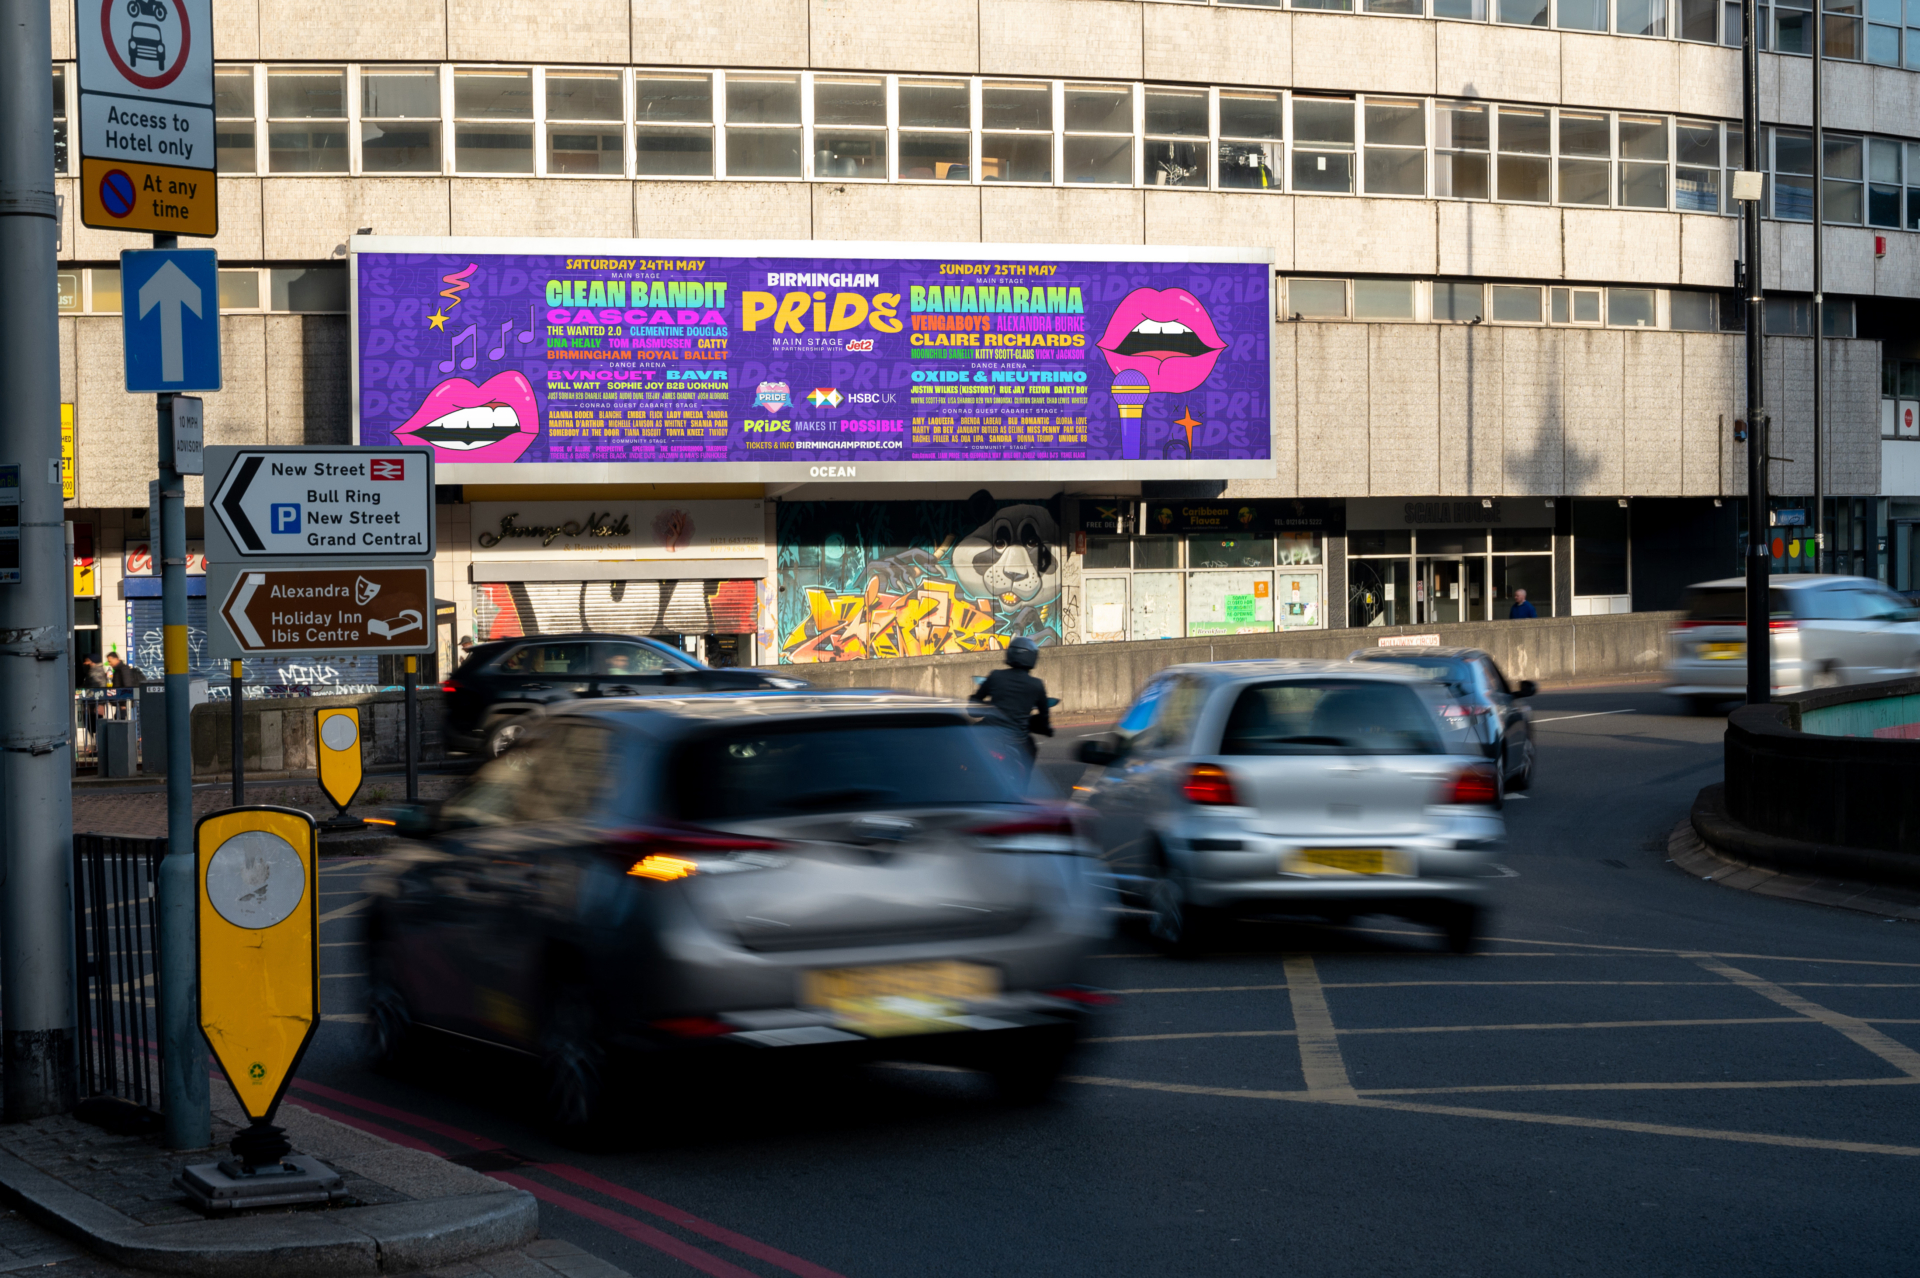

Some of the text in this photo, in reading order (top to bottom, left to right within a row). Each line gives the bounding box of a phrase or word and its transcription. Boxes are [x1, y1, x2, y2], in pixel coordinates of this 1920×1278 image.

[108, 106, 189, 132] Access to
[106, 130, 193, 160] Hotel only
[143, 174, 197, 200] At any
[152, 199, 189, 219] time
[566, 259, 706, 271] SATURDAY 24TH MAY
[940, 264, 1057, 276] SUNDAY 25TH MAY
[768, 273, 879, 287] BIRMINGHAM
[546, 280, 727, 308] CLEAN BANDIT
[910, 285, 1084, 314] BANANARAMA
[547, 309, 727, 325] CASCADA
[911, 315, 1085, 332] VENGABOYS ALEXANDRA BURKE
[547, 326, 728, 336] THE WANTED 2.0 CLEMENTINE DOUGLAS
[547, 338, 727, 348] UNA HEALY TOM RASMUSSEN CATTY
[773, 338, 802, 346] MAIN
[808, 338, 843, 346] STAGE
[910, 334, 1085, 347] CLAIRE RICHARDS
[548, 350, 728, 360] BIRMINGHAM ROYAL BALLET
[911, 349, 1085, 359] MOONCHILD SANELLY KITTY SCOTT-CLAUS VICKY JACKSON
[548, 370, 727, 380] BVNQUET BAVR
[911, 371, 1087, 382] OXIDE & NEUTRINO
[548, 382, 728, 390] WILL WATT SOPHIE JOY B2B UOKHUN
[911, 385, 1088, 395] JUSTIN WILKES (KISSTORY) RUE JAY FELTON DAVEY BOY
[759, 394, 787, 402] PRIDE
[848, 394, 896, 403] HSBC UK
[179, 416, 198, 429] 10 MPH
[795, 422, 826, 431] MAKES
[829, 422, 837, 431] IT
[841, 420, 904, 432] POSSIBLE
[177, 440, 202, 453] ADVISORY
[796, 441, 902, 449] BIRMINGHAMPRIDE.COM
[272, 463, 365, 476] New Street
[810, 466, 856, 477] OCEAN
[307, 490, 381, 505] Bull Ring
[1182, 507, 1229, 516] Caribbean
[1405, 502, 1501, 524] SCALA HOUSE
[278, 507, 400, 531] P New Street
[1191, 516, 1220, 525] Flavaz
[479, 512, 631, 548] Jenny Nails
[307, 532, 422, 546] Grand Central
[575, 544, 603, 553] Beauty
[608, 543, 631, 551] Salon
[271, 584, 350, 598] Alexandra
[272, 611, 362, 626] Holiday Inn
[272, 628, 359, 642] Ibis Centre
[1381, 637, 1438, 647] HOLLOWAY CIRCUS
